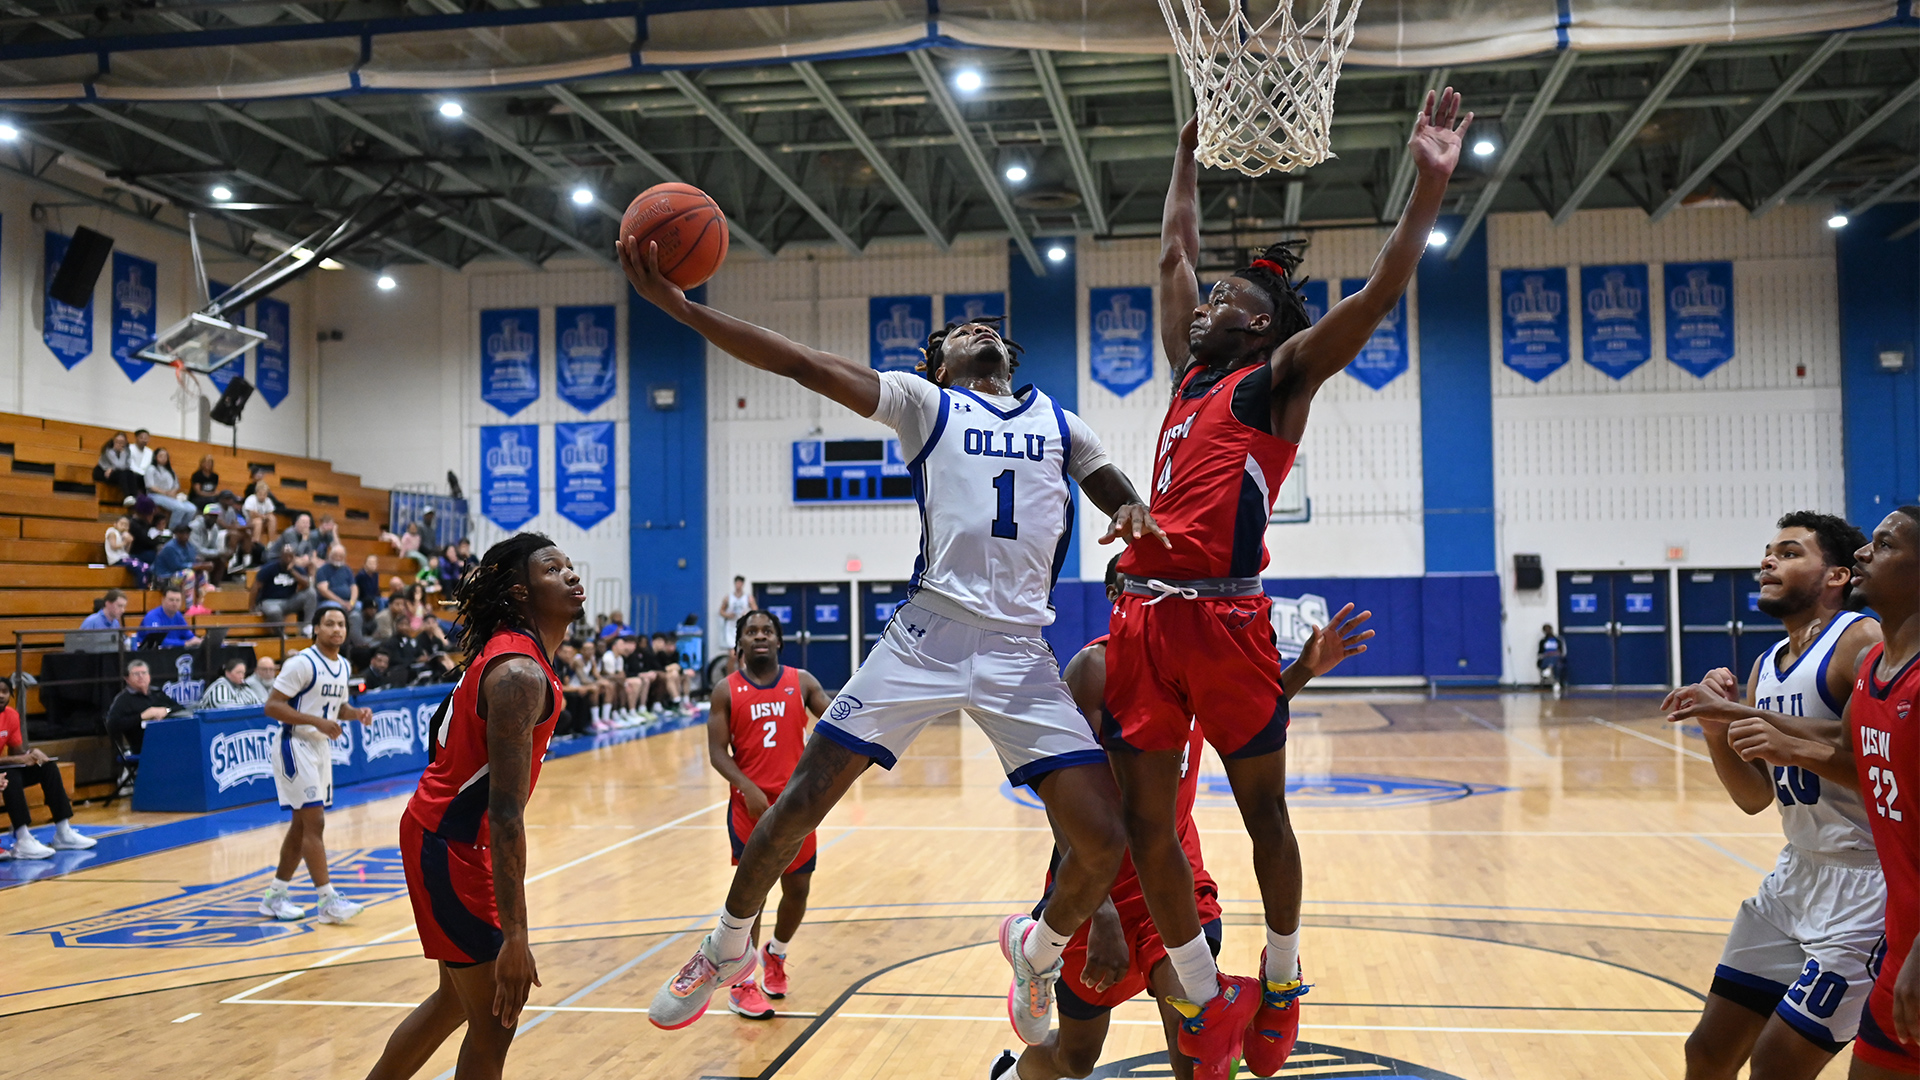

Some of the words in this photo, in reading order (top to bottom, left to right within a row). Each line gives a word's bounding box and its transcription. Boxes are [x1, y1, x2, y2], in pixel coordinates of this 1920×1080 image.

[487, 447, 532, 470] OLLU
[562, 444, 608, 466] OLLU
[964, 428, 1045, 462] OLLU
[1157, 455, 1172, 494] 4
[991, 469, 1018, 540] 1
[750, 701, 786, 721] USW
[763, 721, 777, 748] 2
[1860, 725, 1891, 762] USW
[1774, 766, 1821, 806] 20
[1868, 766, 1903, 822] 22
[1787, 958, 1849, 1019] 20
